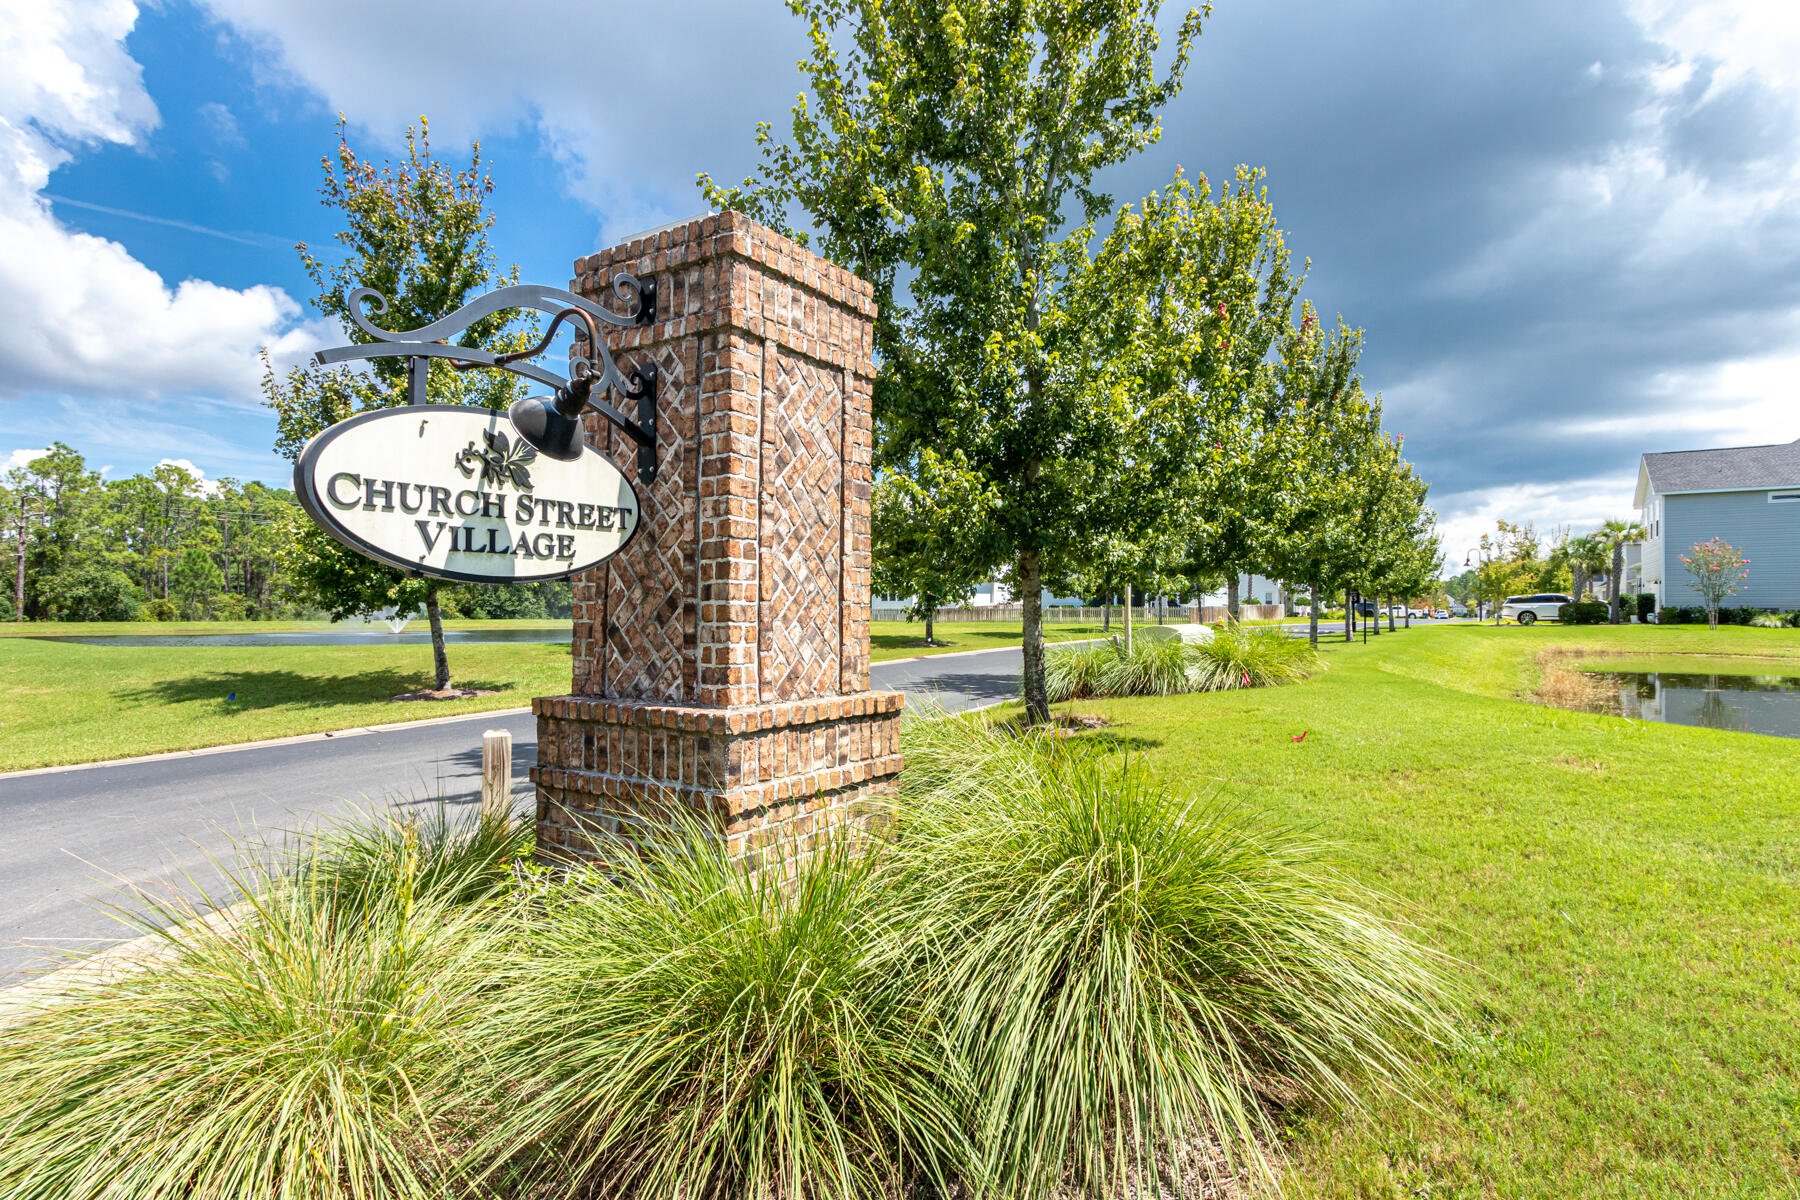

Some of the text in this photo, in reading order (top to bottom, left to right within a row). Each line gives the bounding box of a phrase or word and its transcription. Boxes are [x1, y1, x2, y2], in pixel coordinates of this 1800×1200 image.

[328, 472, 632, 531] CHURCH STREET
[415, 520, 577, 559] VILLAGE
